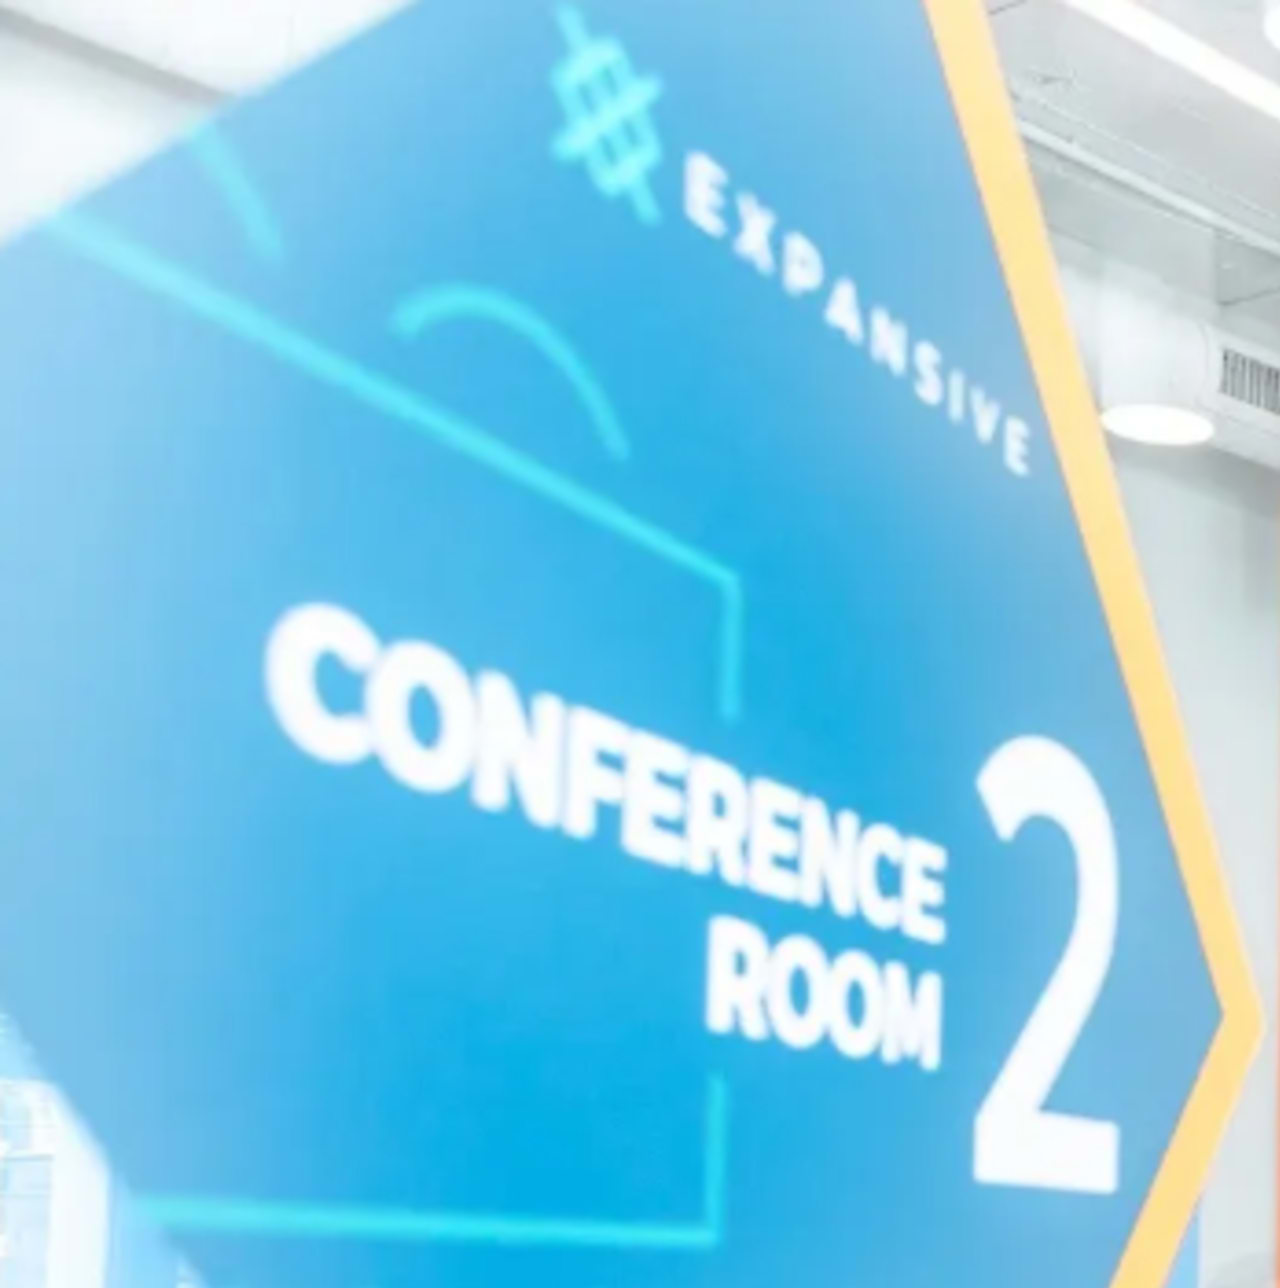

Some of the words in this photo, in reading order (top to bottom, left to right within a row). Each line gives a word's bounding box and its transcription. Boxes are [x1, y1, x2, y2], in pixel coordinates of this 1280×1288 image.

[686, 153, 1030, 475] EXPANSIVE
[265, 603, 945, 943] CONFERENCE
[706, 916, 942, 1069] ROOM
[974, 735, 1119, 1195] 2
